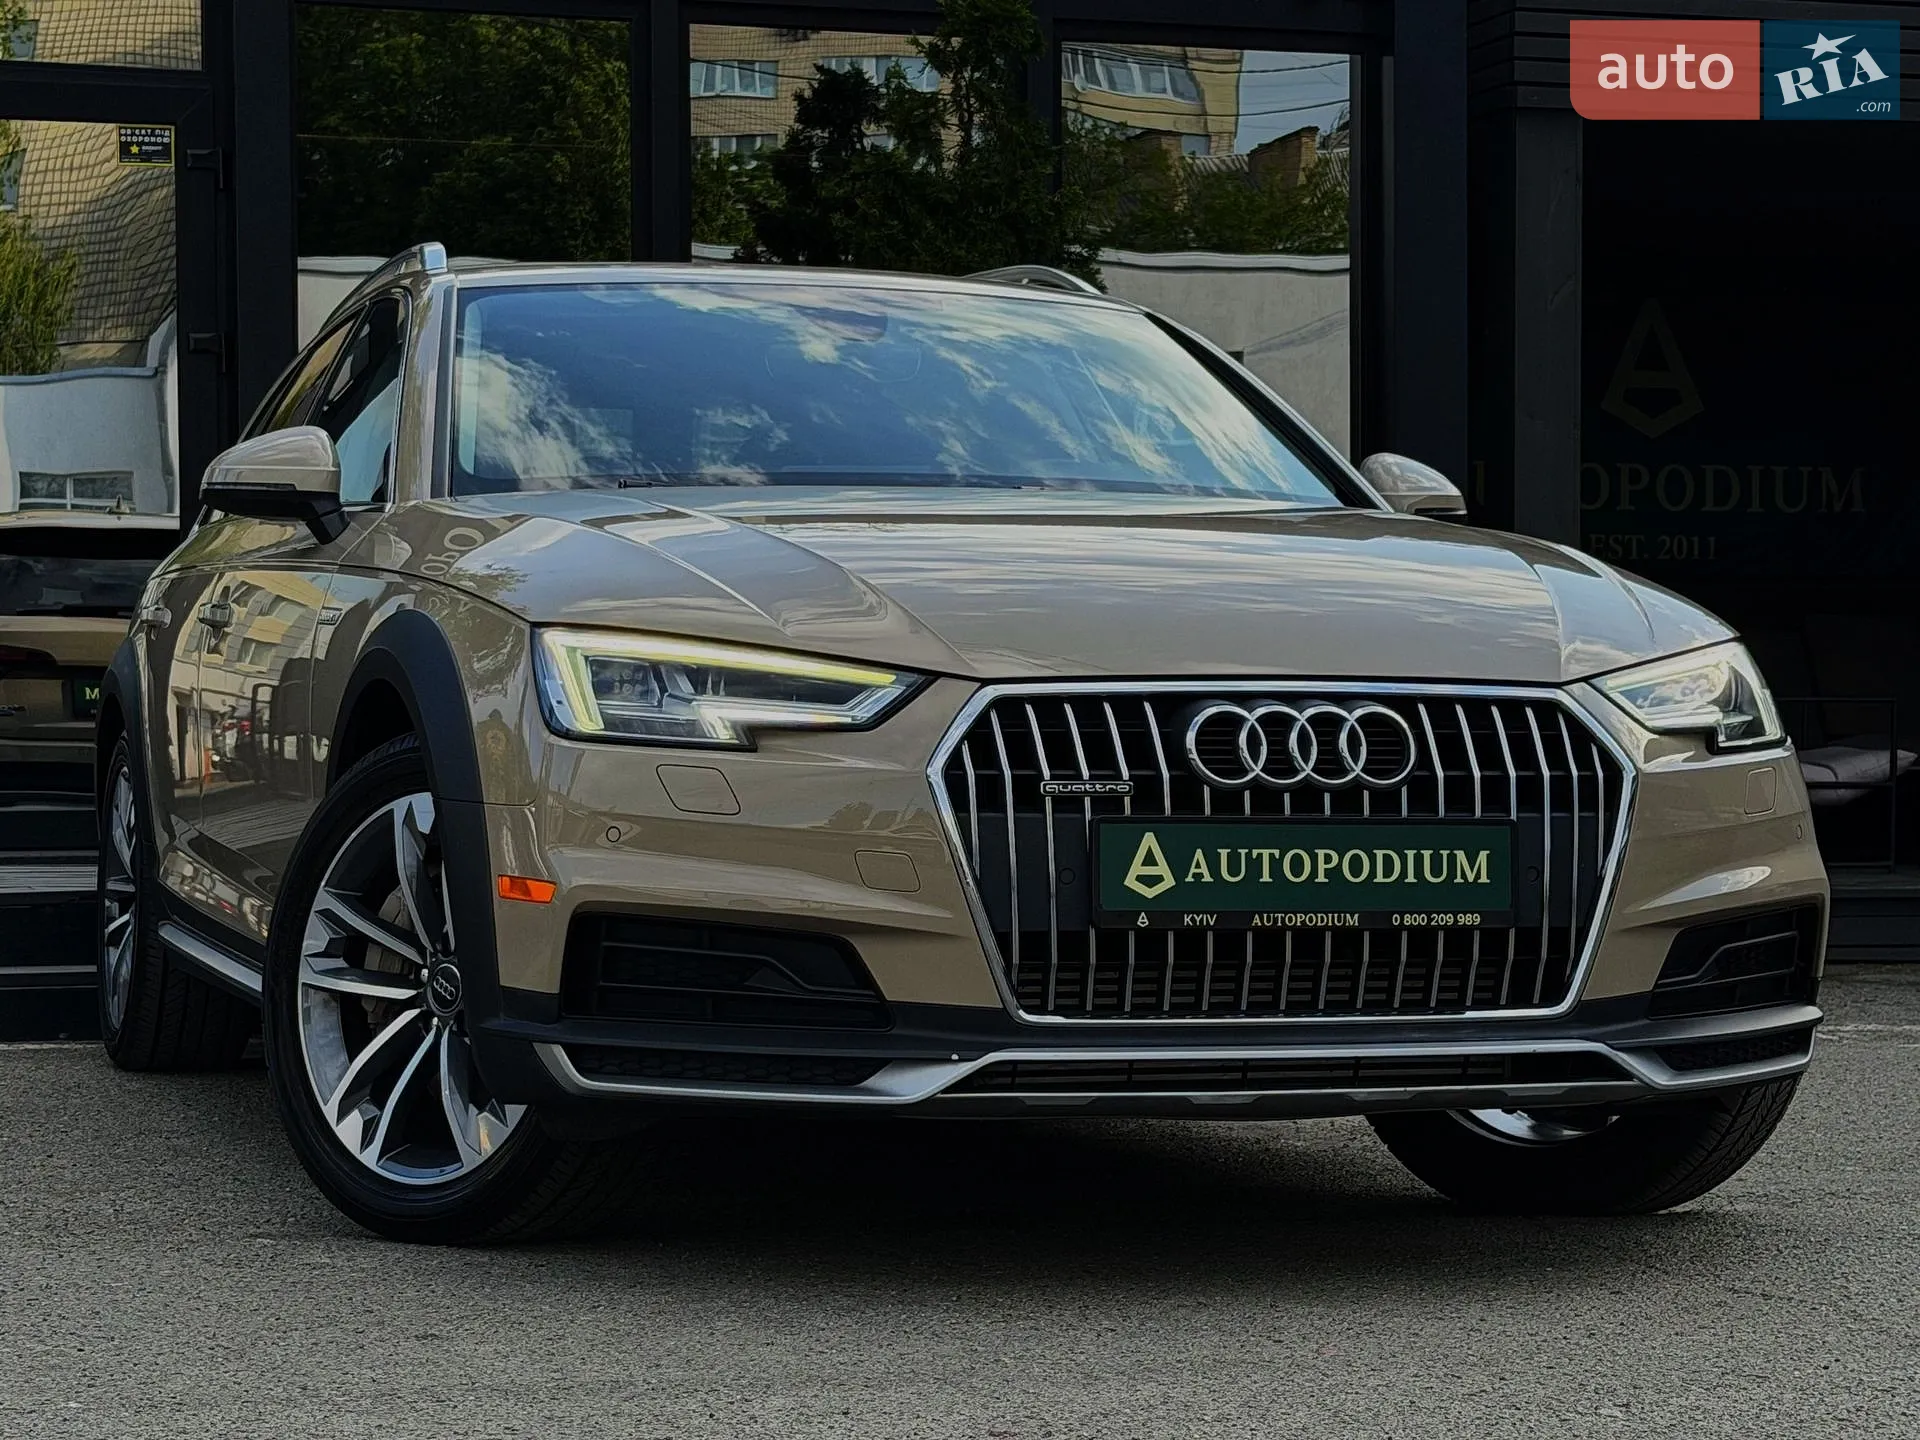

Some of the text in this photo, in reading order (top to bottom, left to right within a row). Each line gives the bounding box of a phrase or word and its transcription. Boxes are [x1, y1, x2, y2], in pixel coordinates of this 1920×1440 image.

[1658, 535, 1717, 561] 2011
[1045, 783, 1130, 794] quattro
[1185, 848, 1491, 884] AUTOPODIUM
[1184, 913, 1481, 927] KYIV AUTOPODIUM 0 800 209 989
